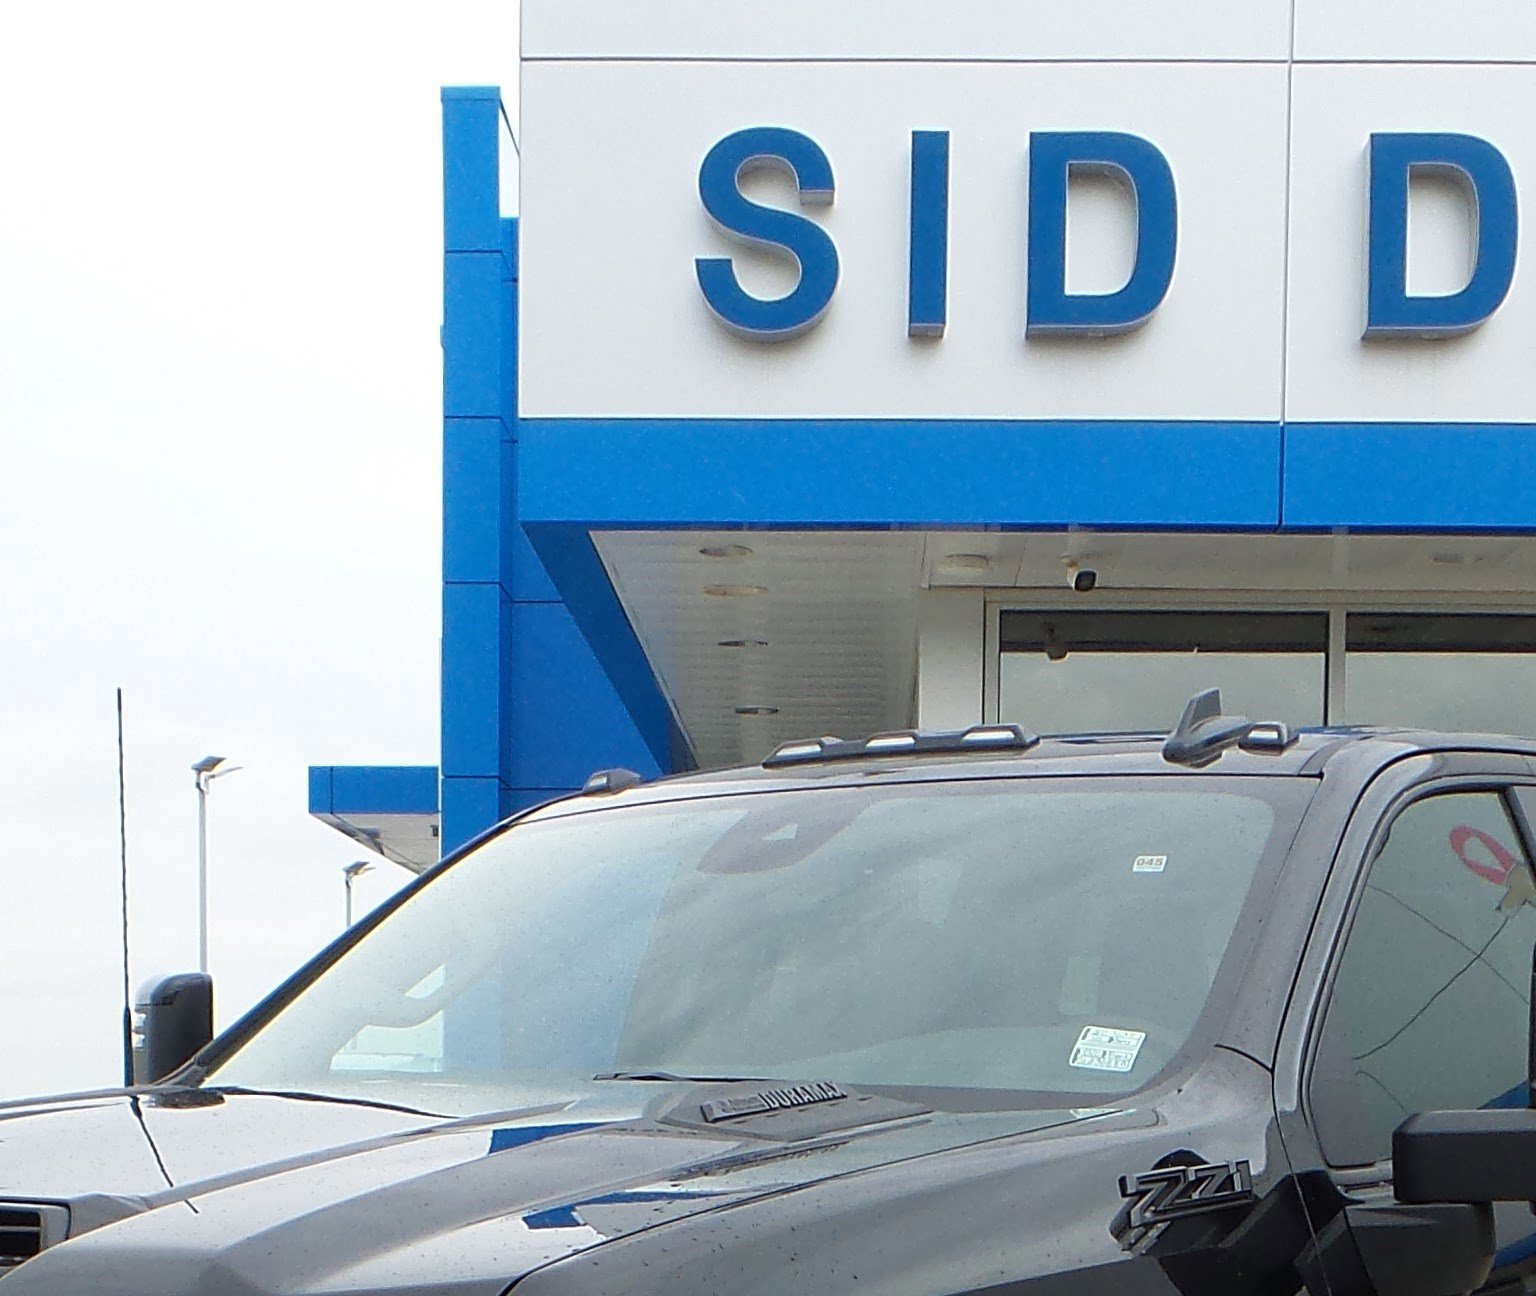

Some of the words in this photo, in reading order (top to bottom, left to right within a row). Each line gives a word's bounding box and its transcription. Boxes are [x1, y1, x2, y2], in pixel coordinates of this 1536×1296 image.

[695, 126, 1178, 342] SID
[757, 1081, 848, 1110] DURAMAX
[1124, 1158, 1254, 1229] Z71
